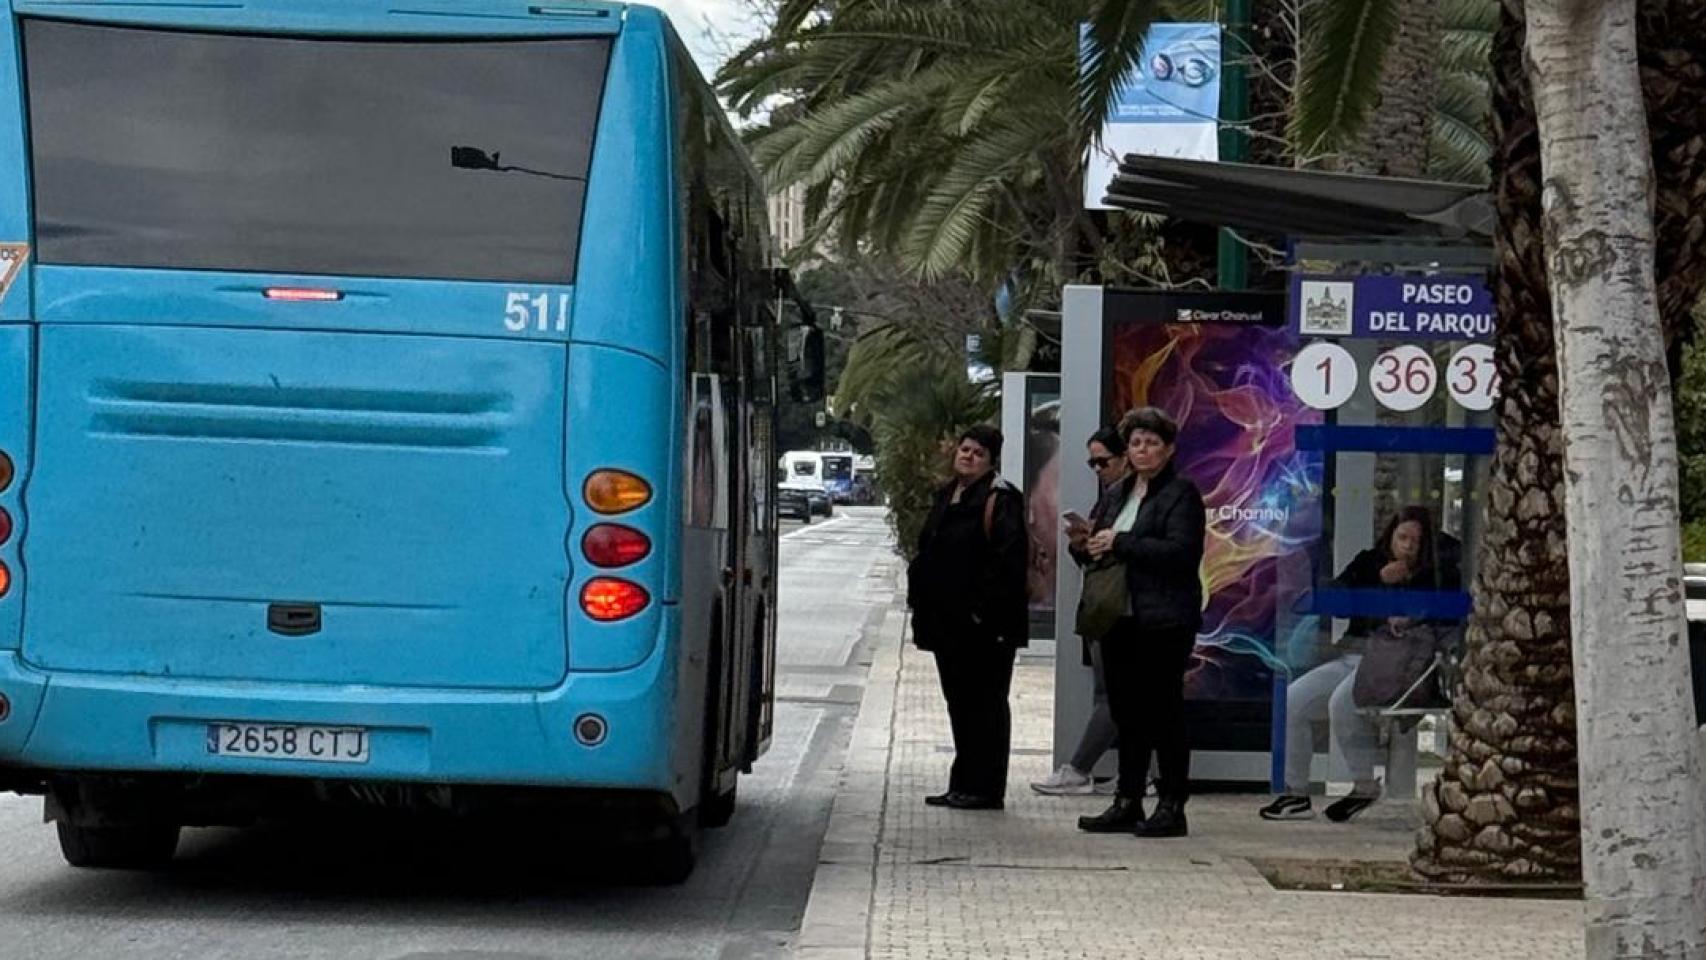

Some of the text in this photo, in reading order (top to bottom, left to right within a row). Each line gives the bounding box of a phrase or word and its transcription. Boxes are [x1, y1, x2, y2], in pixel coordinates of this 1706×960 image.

[1402, 283, 1473, 305] PASEO
[1369, 311, 1497, 338] DEL PARQU
[1316, 354, 1500, 397] 1 36 37
[1219, 505, 1289, 521] Channel
[225, 724, 298, 755] 2658
[309, 728, 363, 757] CTJ
